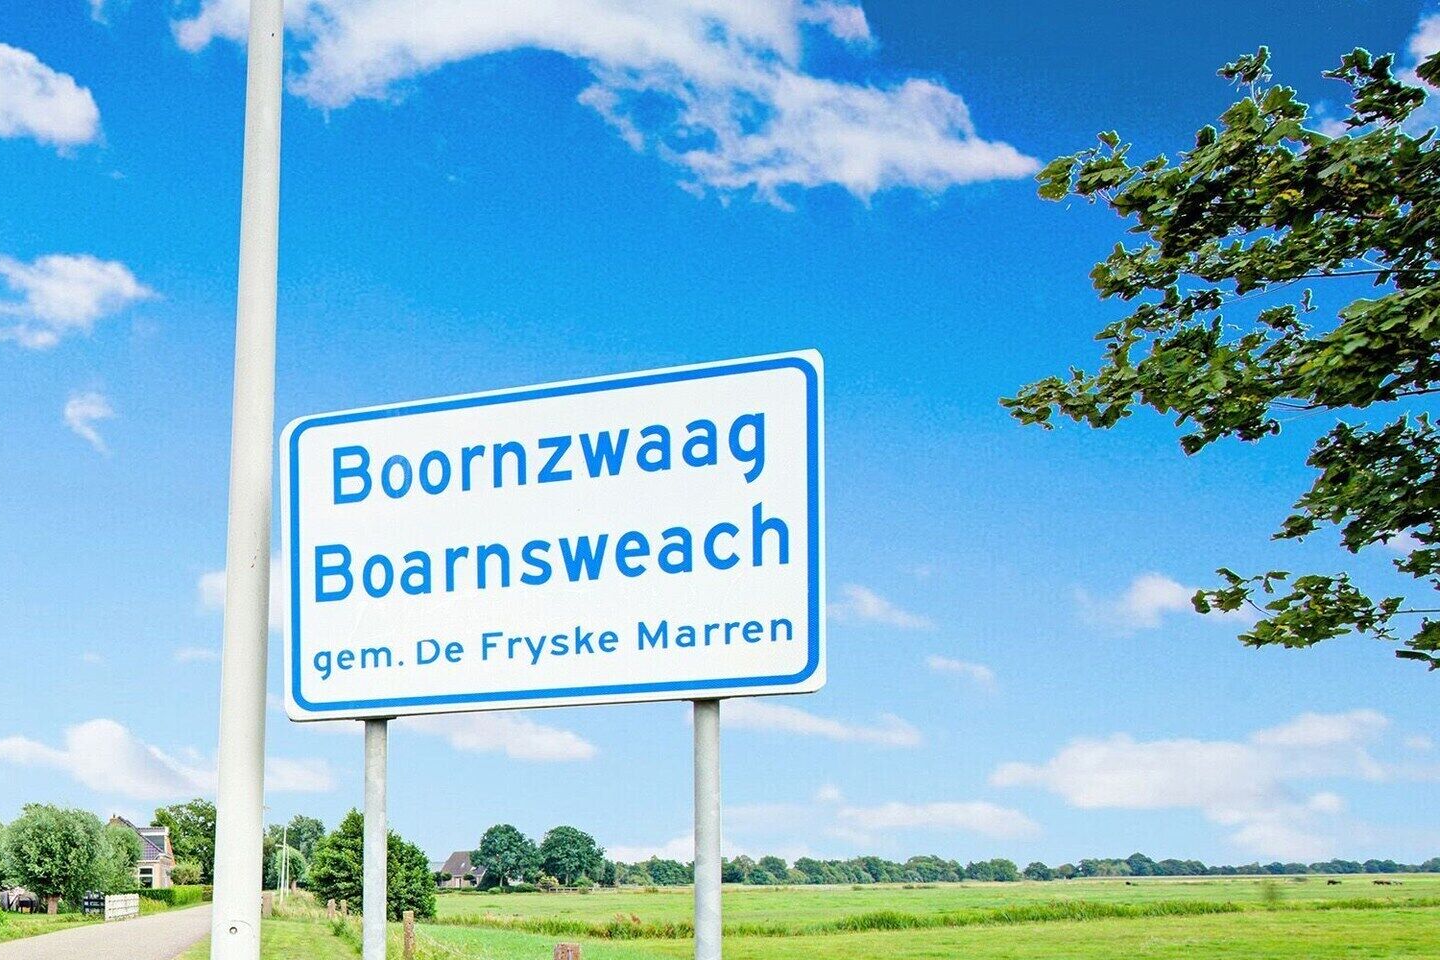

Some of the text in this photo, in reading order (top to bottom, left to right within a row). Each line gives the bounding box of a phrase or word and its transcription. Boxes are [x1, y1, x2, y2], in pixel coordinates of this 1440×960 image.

[333, 413, 766, 505] Boornzwaag
[315, 502, 790, 602] Boarnsweach
[313, 617, 793, 681] gem. De Fryske Marren
